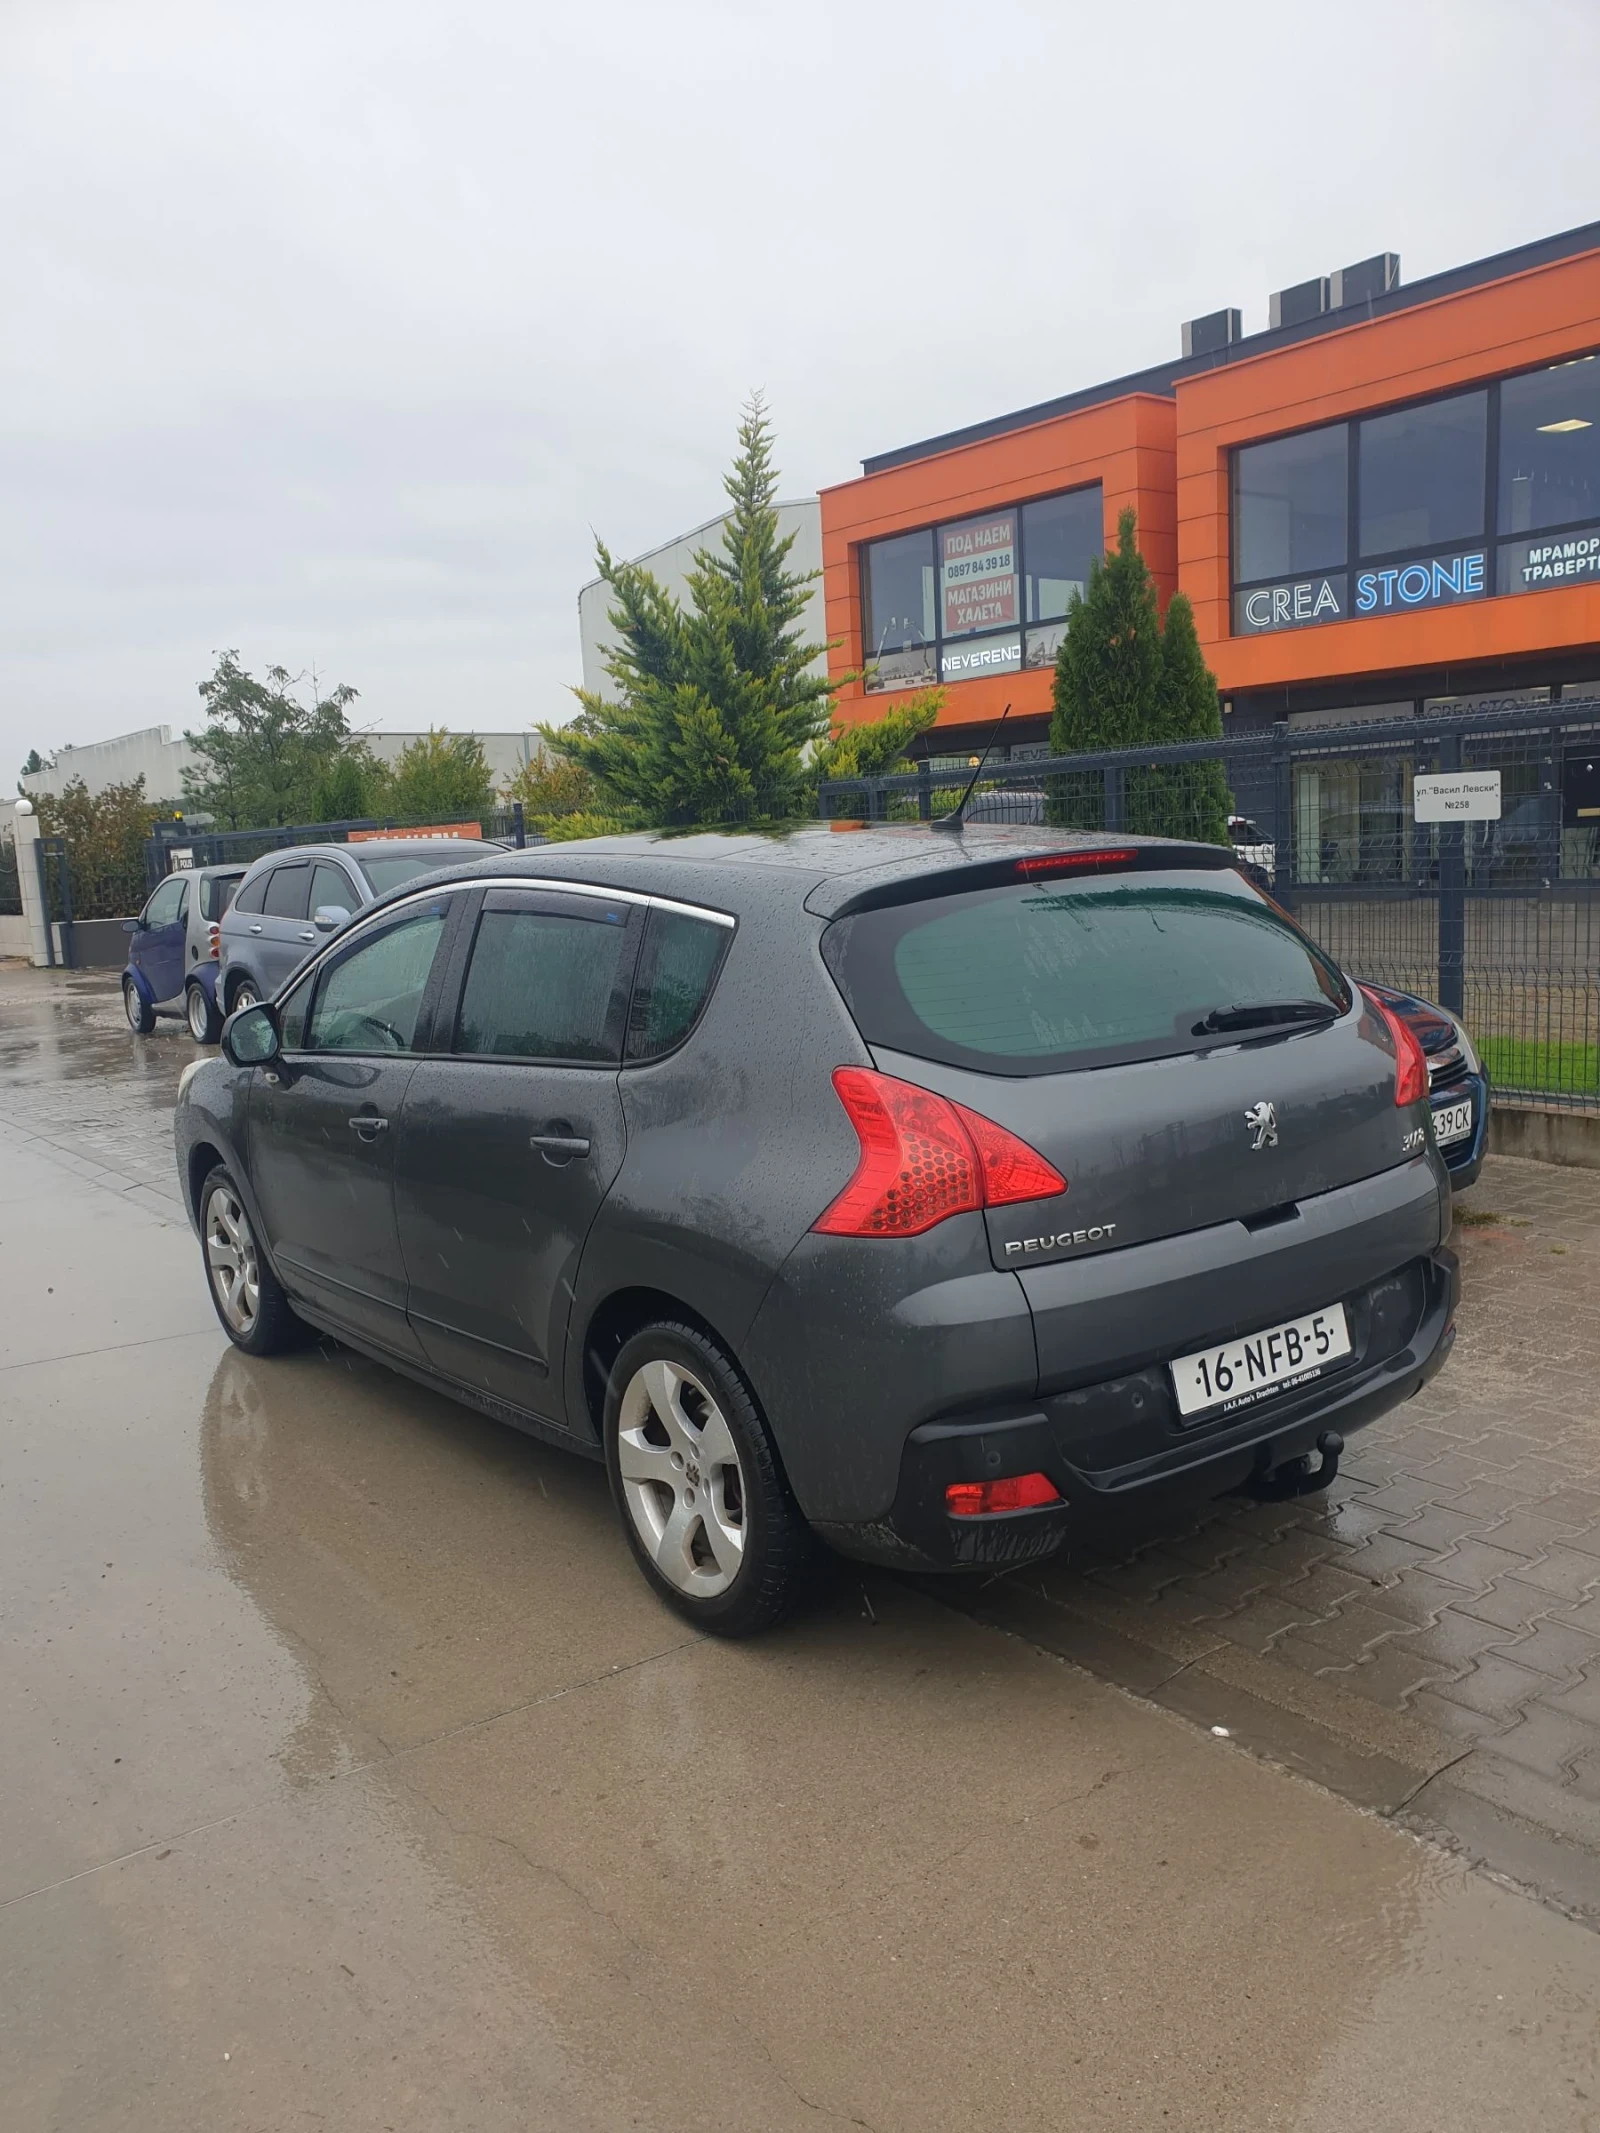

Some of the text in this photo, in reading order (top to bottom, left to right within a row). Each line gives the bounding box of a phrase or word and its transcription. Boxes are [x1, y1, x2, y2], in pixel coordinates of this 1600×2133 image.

[946, 524, 1011, 554] ПОД НАЕМ
[1529, 538, 1600, 564] МРАМОР
[947, 554, 1011, 579] 0897 84 39 18
[947, 578, 1012, 607] МАГАЗИНИ
[1245, 554, 1484, 626] CREA STONE
[957, 601, 1003, 625] ХАЛЕТА
[941, 645, 1021, 672] NEVEREND
[1462, 783, 1499, 793] Левски"
[1444, 800, 1470, 809] №258
[1455, 1104, 1470, 1130] CK
[1004, 1223, 1117, 1256] PEUGEOT
[1197, 1316, 1330, 1398] 16-NFB-5
[1238, 1394, 1255, 1406] Auto's
[1256, 1385, 1279, 1399] Drachten
